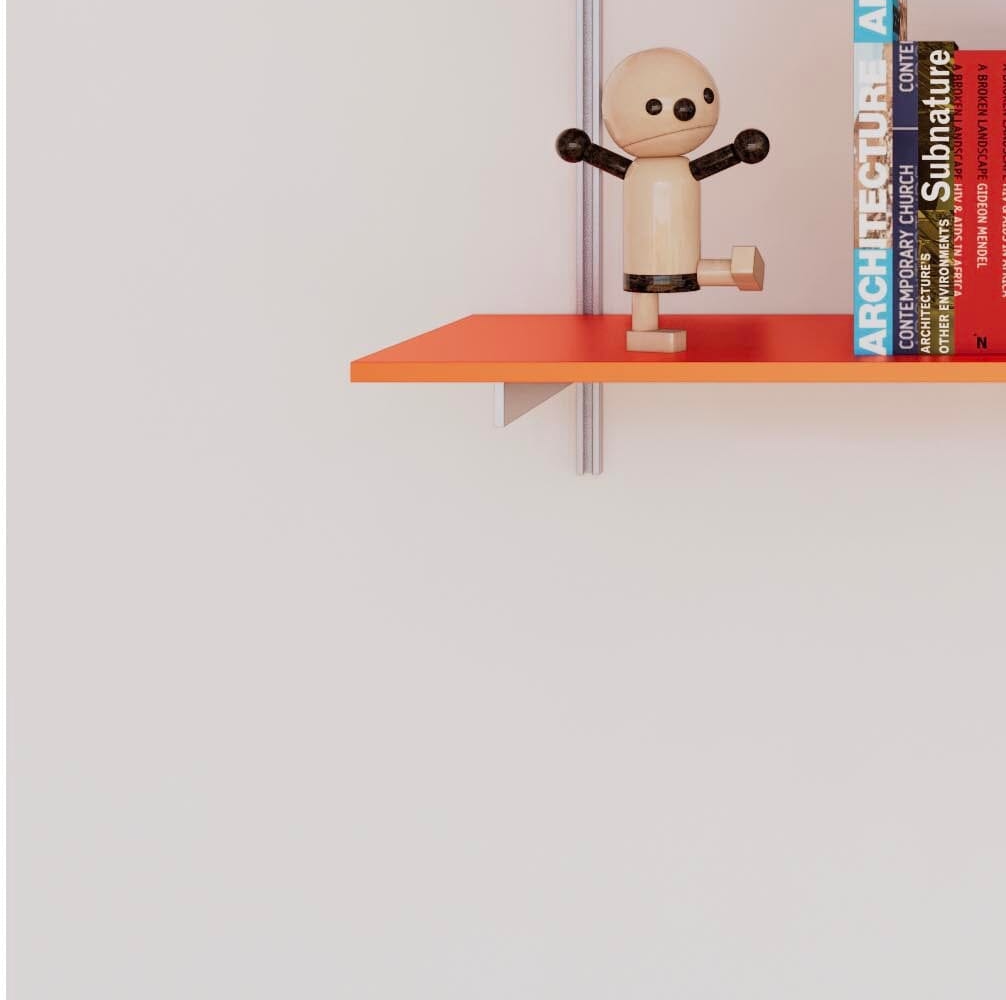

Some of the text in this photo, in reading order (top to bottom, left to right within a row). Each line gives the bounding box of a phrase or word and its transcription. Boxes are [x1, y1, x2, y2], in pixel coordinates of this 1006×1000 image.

[898, 41, 914, 93] CONTE
[921, 49, 950, 202] Subnature
[858, 60, 887, 355] ARCHITECTURE
[977, 64, 988, 268] A BROKEN LANDSCAPE GIDEON MENDEL
[898, 165, 914, 350] CONTEMPORARY CHURCH
[920, 252, 931, 354] ARCHITECTURE'S
[938, 218, 949, 354] OTHER ENVIRONMENTS
